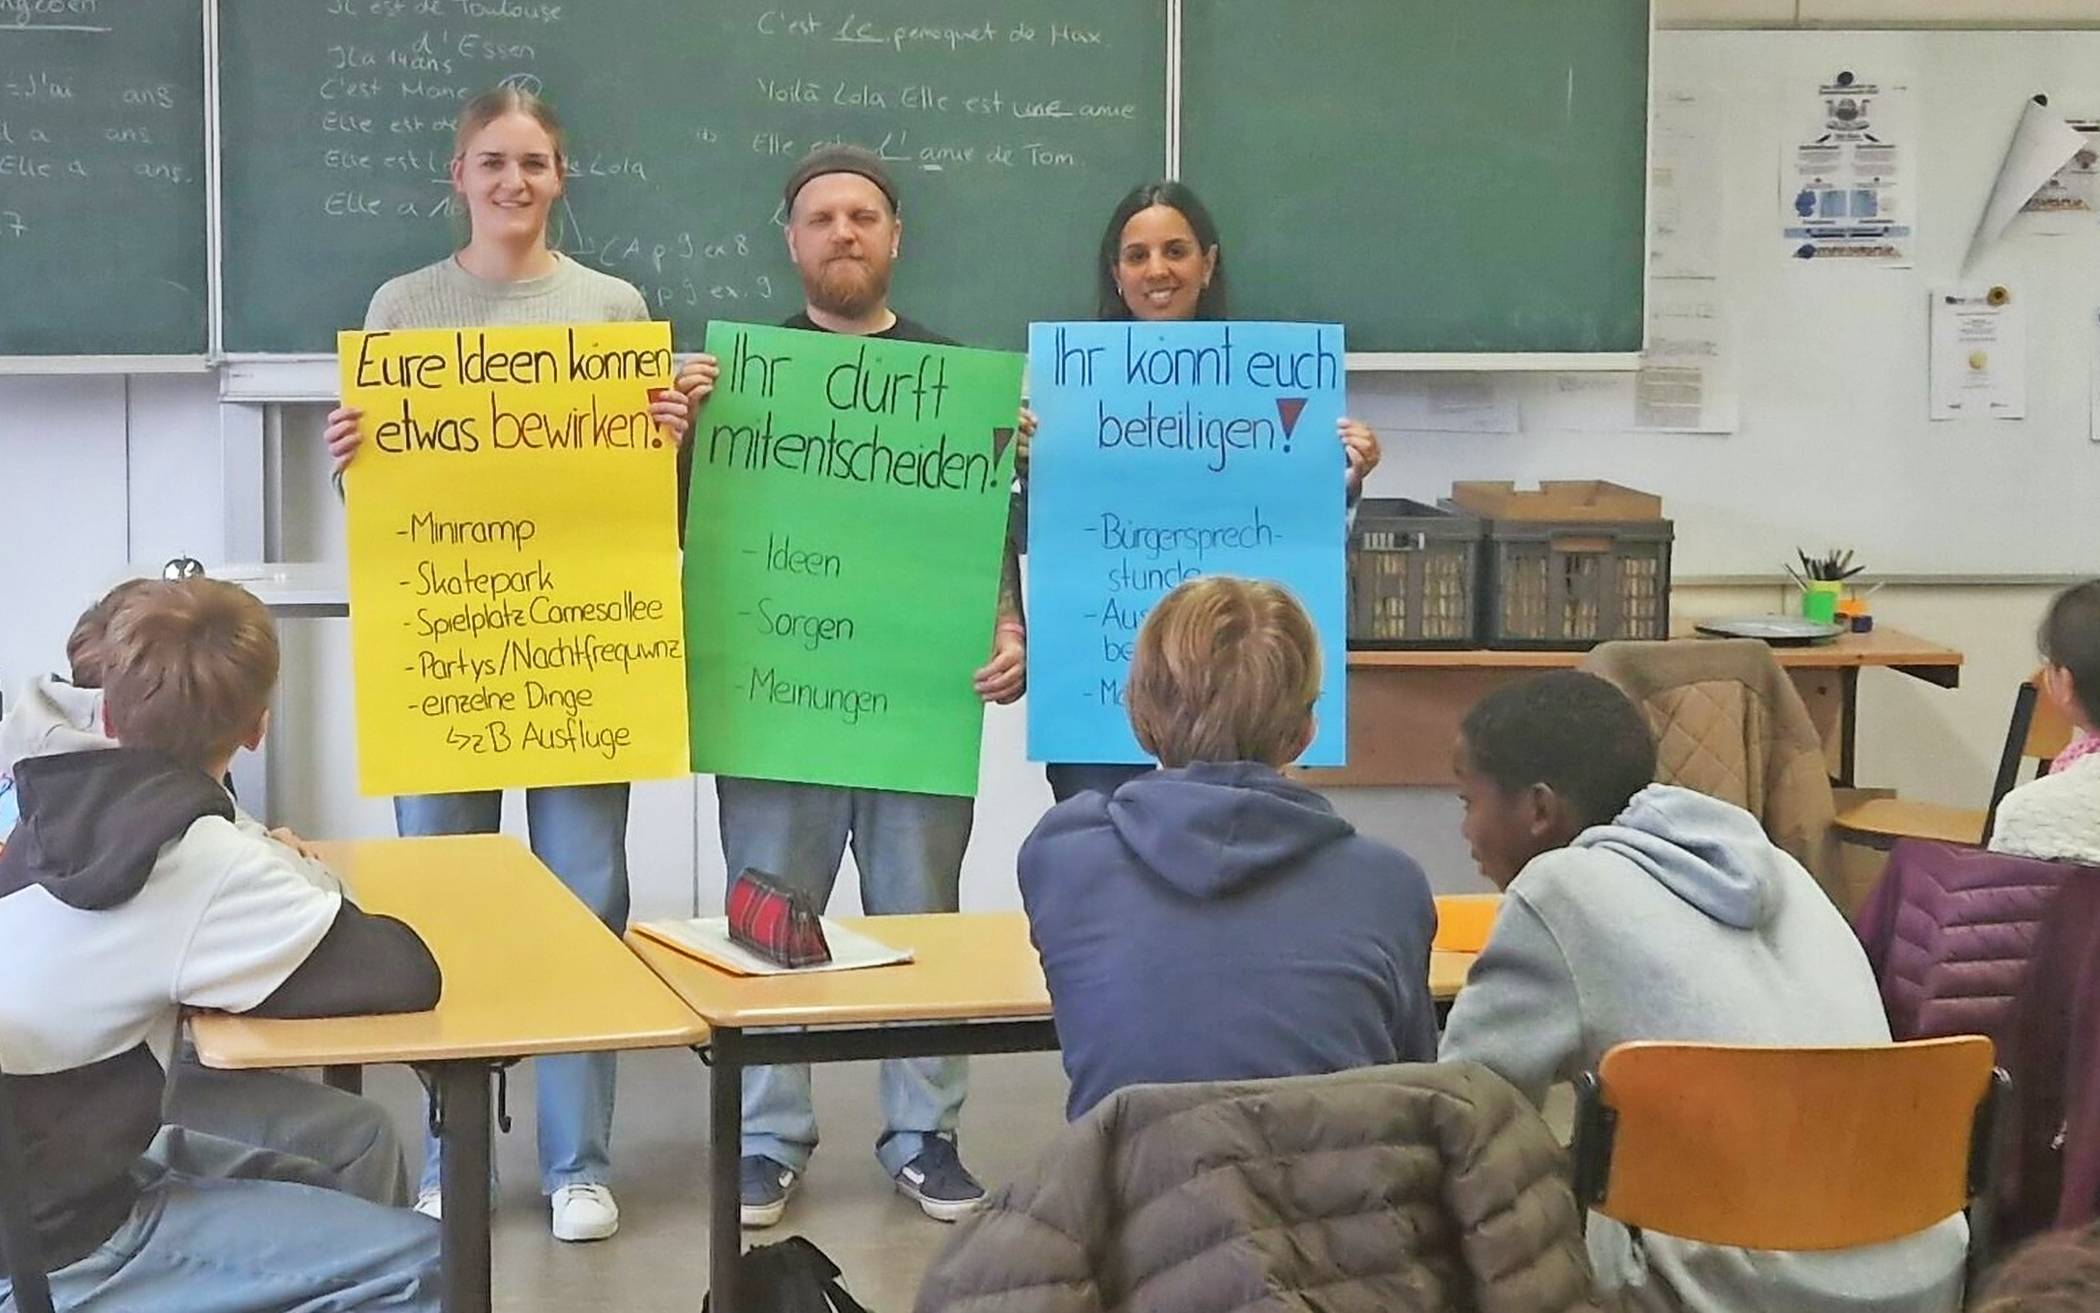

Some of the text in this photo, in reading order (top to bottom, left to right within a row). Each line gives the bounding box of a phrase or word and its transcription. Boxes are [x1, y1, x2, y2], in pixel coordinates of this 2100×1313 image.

[1010, 23, 1035, 42] de
[966, 89, 1004, 114] est
[357, 332, 446, 388] Eure
[457, 332, 557, 385] Ideen
[731, 332, 792, 398] Ihr
[1055, 327, 1105, 387] Ihr
[1247, 329, 1337, 390] euch
[376, 398, 479, 453] etwas
[525, 681, 593, 717] Dinge
